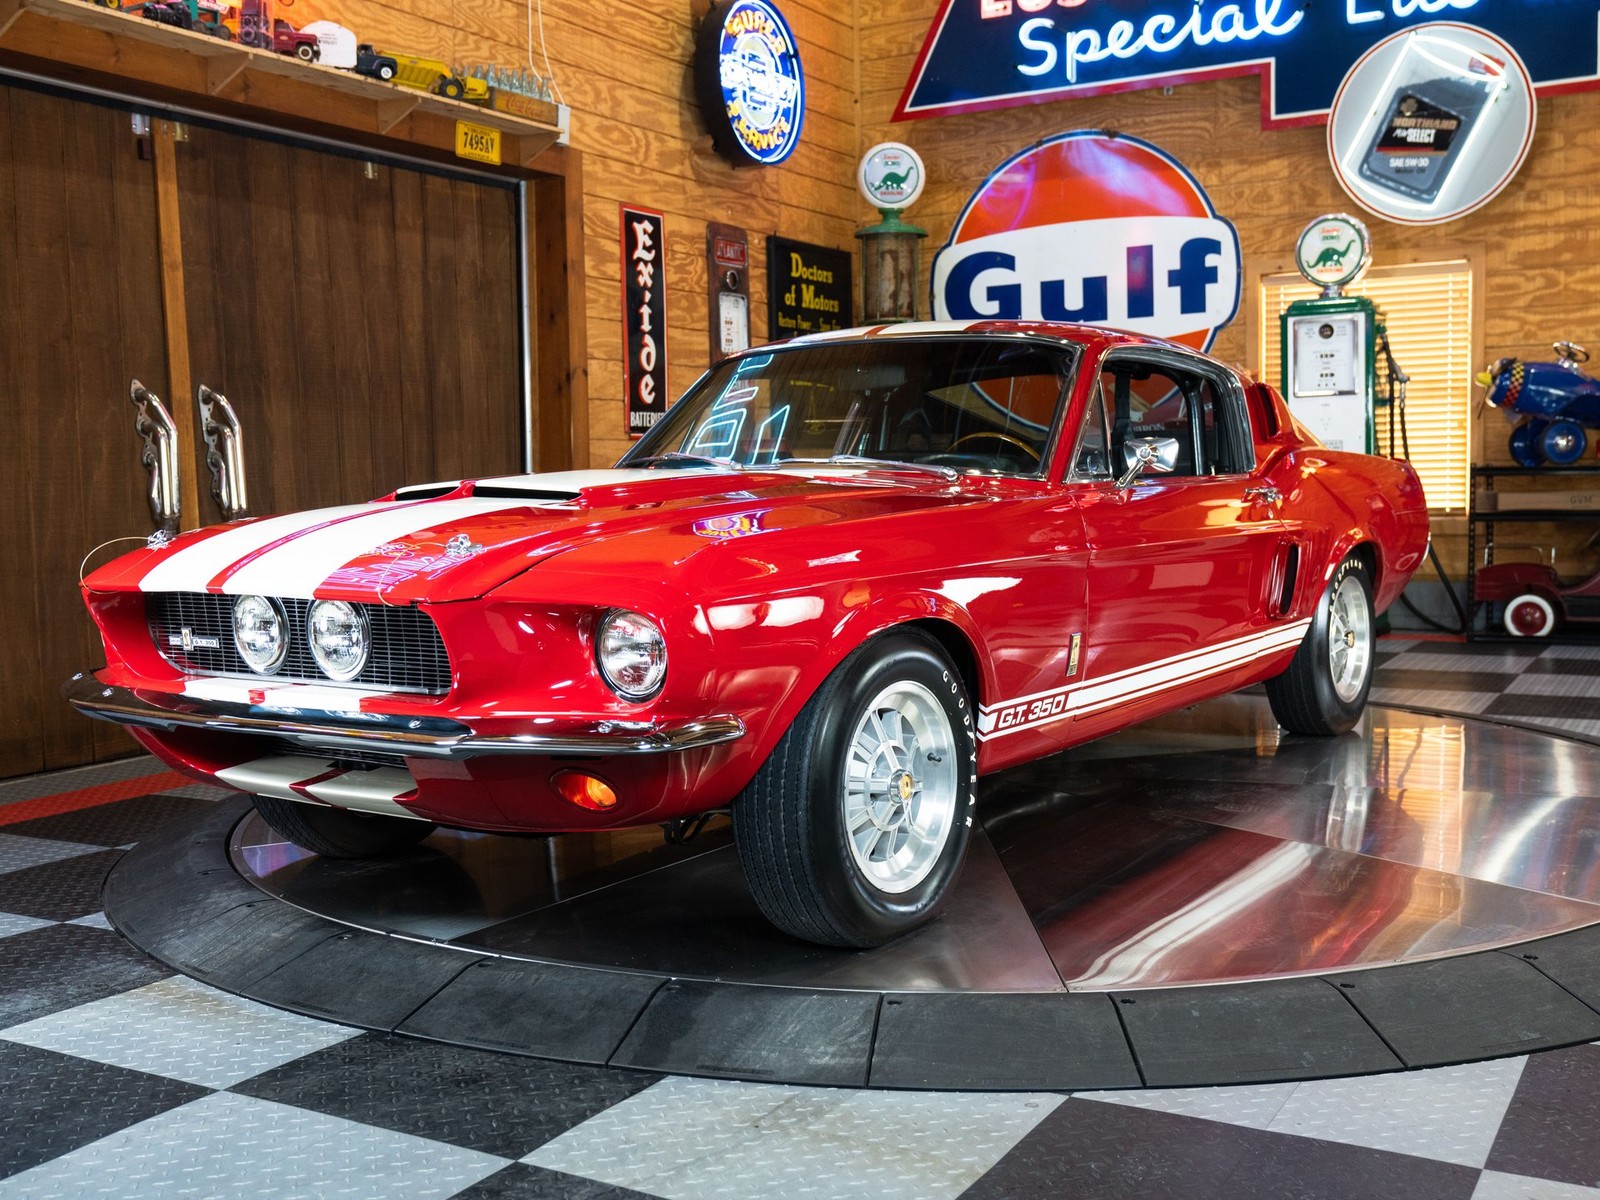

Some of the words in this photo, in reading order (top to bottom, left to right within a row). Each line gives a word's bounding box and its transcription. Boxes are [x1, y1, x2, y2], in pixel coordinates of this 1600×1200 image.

[727, 9, 787, 56] SUPER
[1017, 0, 1304, 83] Special
[1406, 127, 1436, 144] SELECT
[790, 252, 833, 284] Doctors
[945, 237, 1221, 322] Gulf
[631, 219, 657, 405] Exide
[784, 284, 796, 307] of
[801, 283, 839, 313] Motors
[998, 705, 1026, 729] G.T.
[1028, 694, 1066, 721] 350
[942, 669, 977, 828] GOODYEAR
